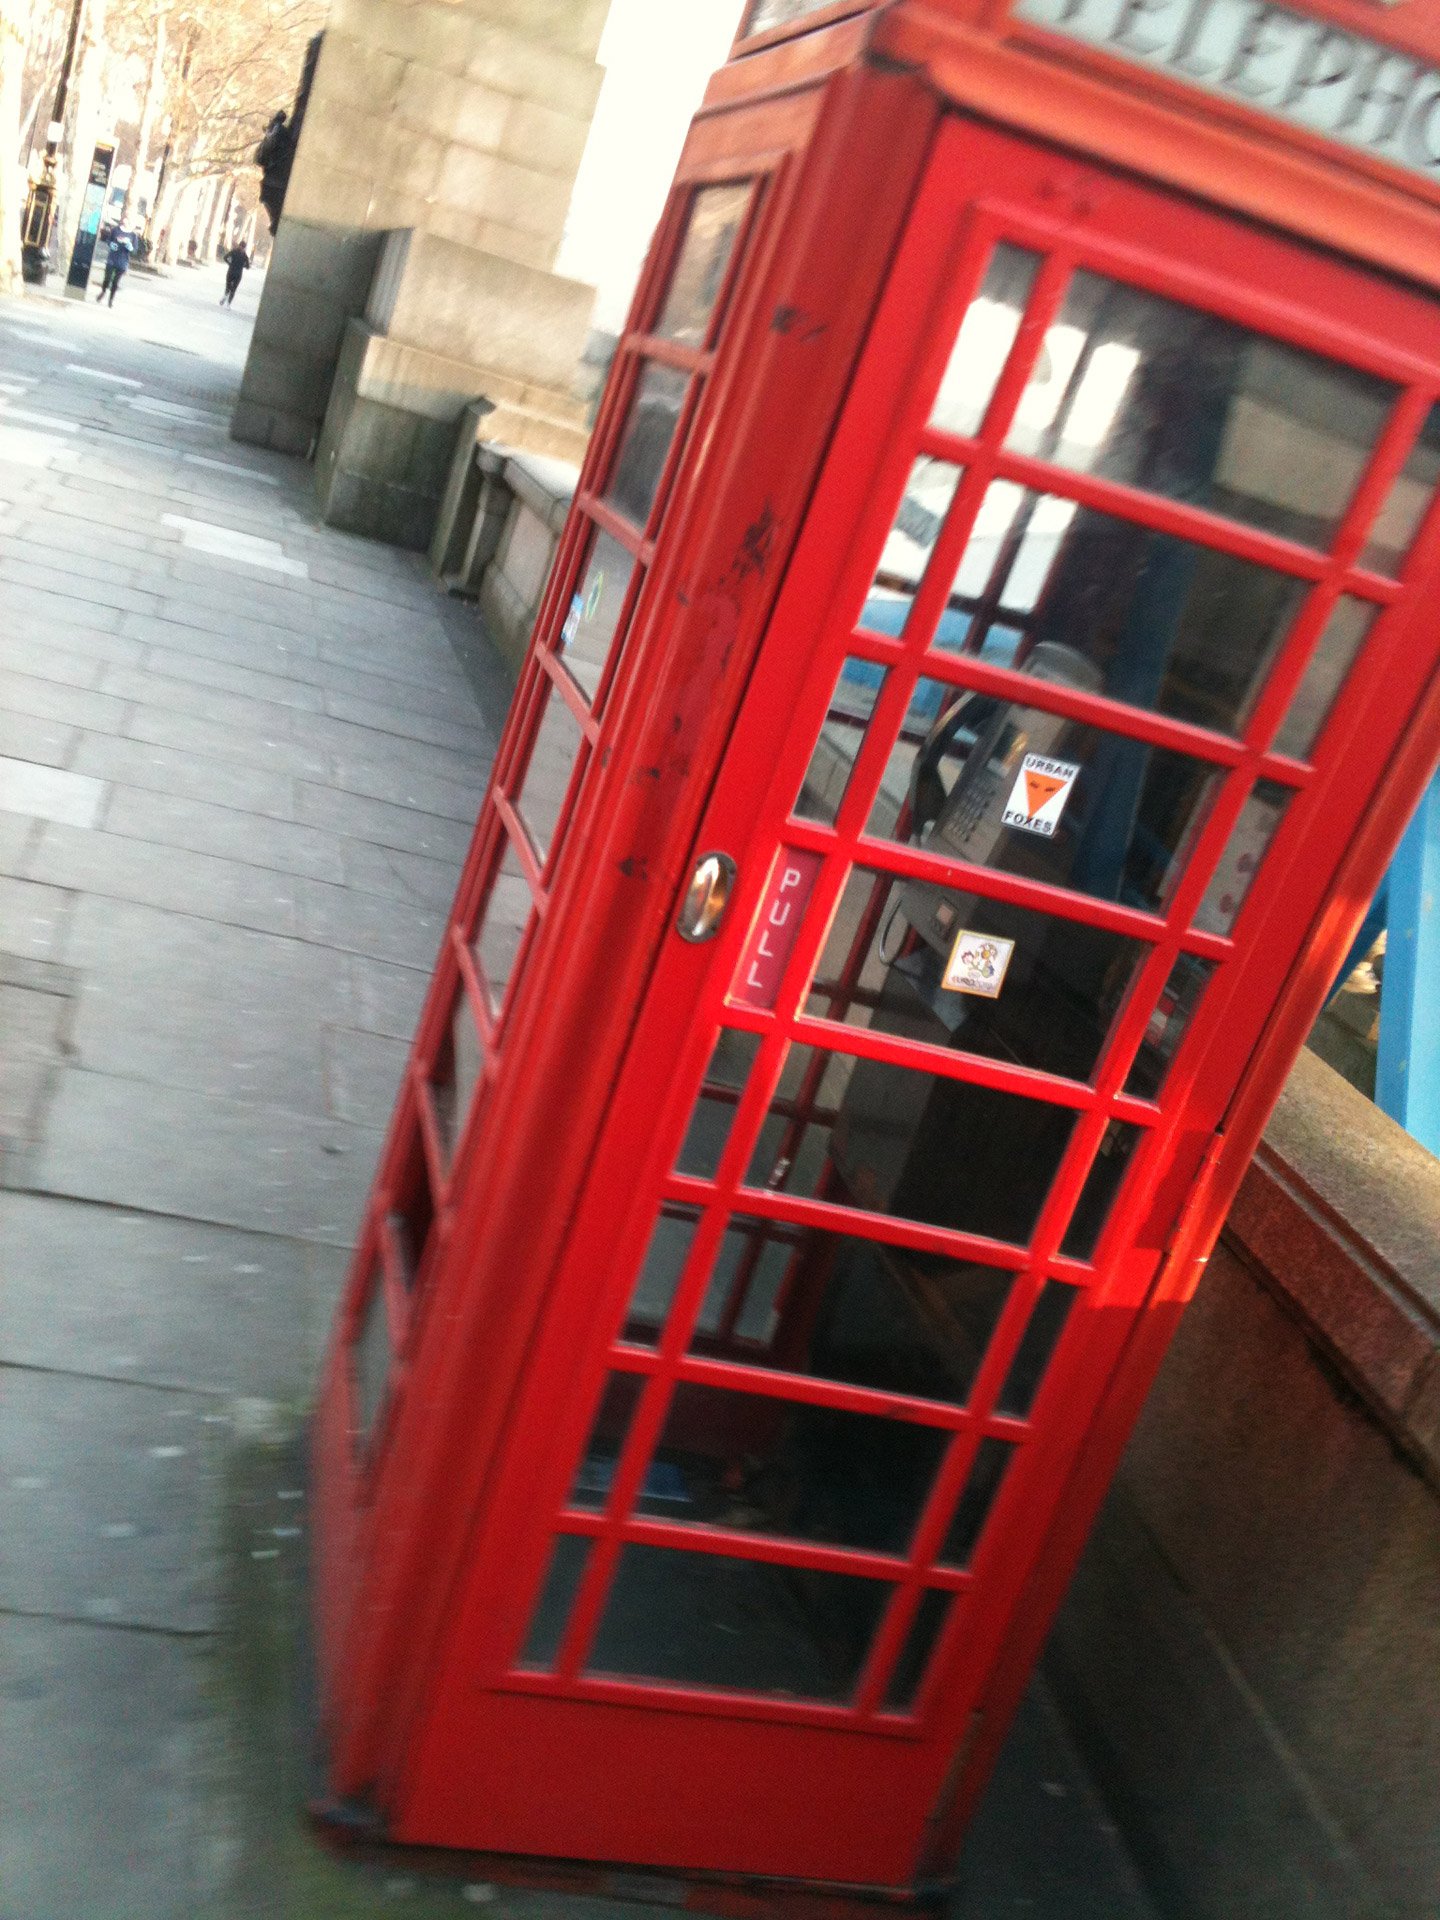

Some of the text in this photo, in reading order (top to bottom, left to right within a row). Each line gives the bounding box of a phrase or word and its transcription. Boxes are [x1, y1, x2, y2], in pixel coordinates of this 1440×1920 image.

[1026, 757, 1074, 779] URBAN
[1004, 811, 1053, 833] FOXES
[747, 868, 801, 988] PULL
